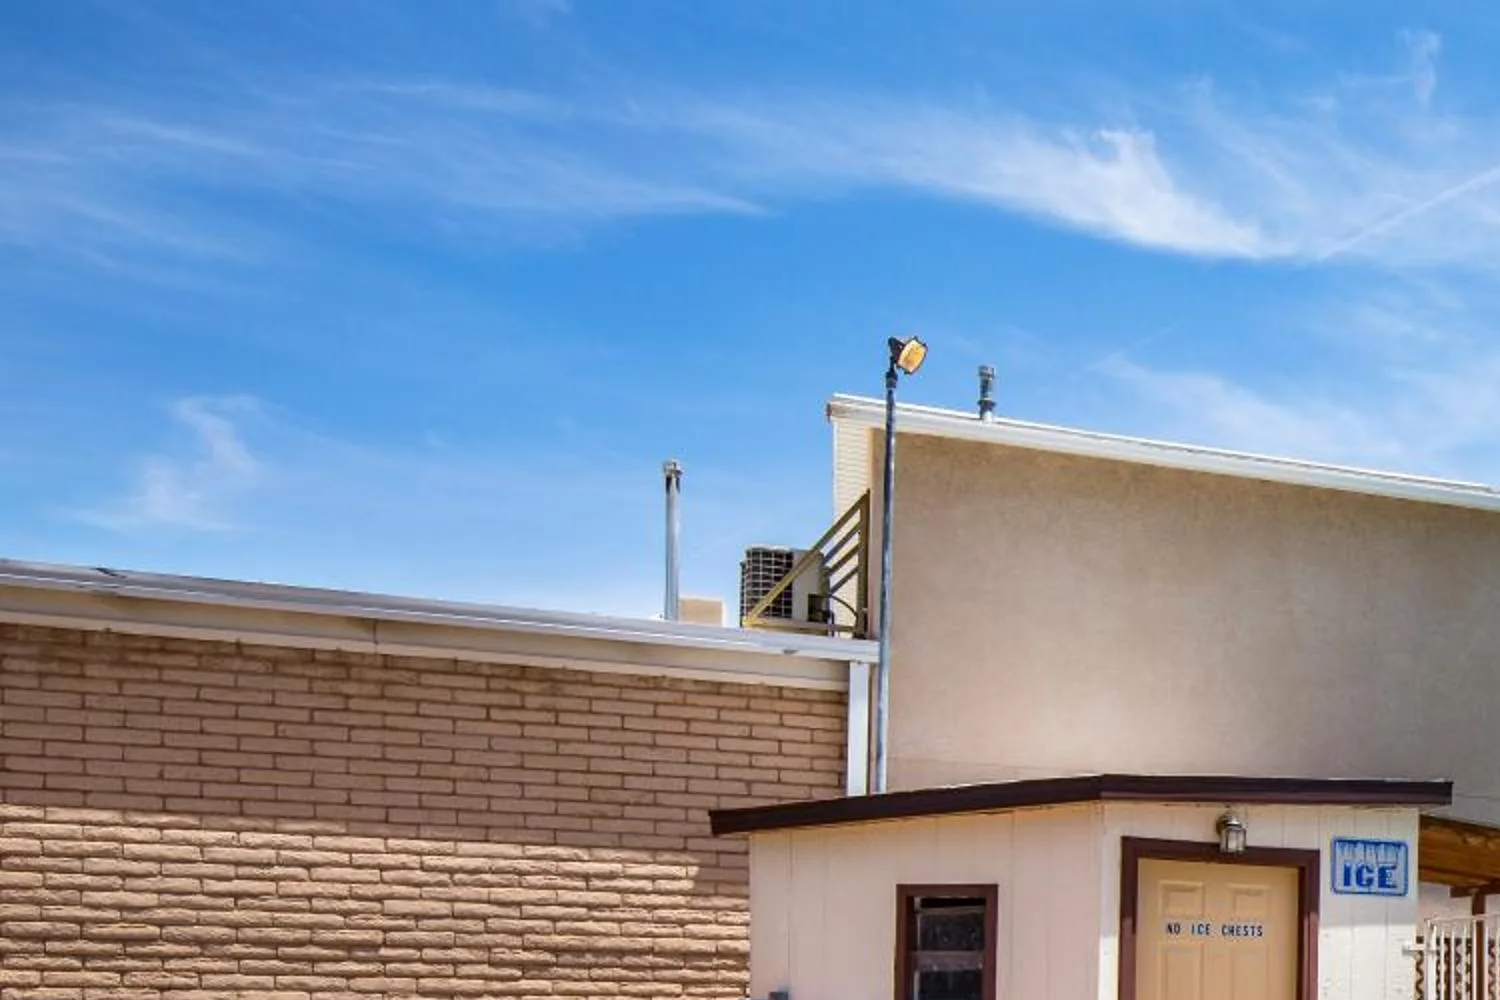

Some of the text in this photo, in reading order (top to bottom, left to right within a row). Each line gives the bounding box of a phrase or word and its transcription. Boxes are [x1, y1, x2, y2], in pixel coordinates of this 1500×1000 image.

[1343, 863, 1397, 889] ICE
[1166, 923, 1263, 937] NO ICE CHESTS
